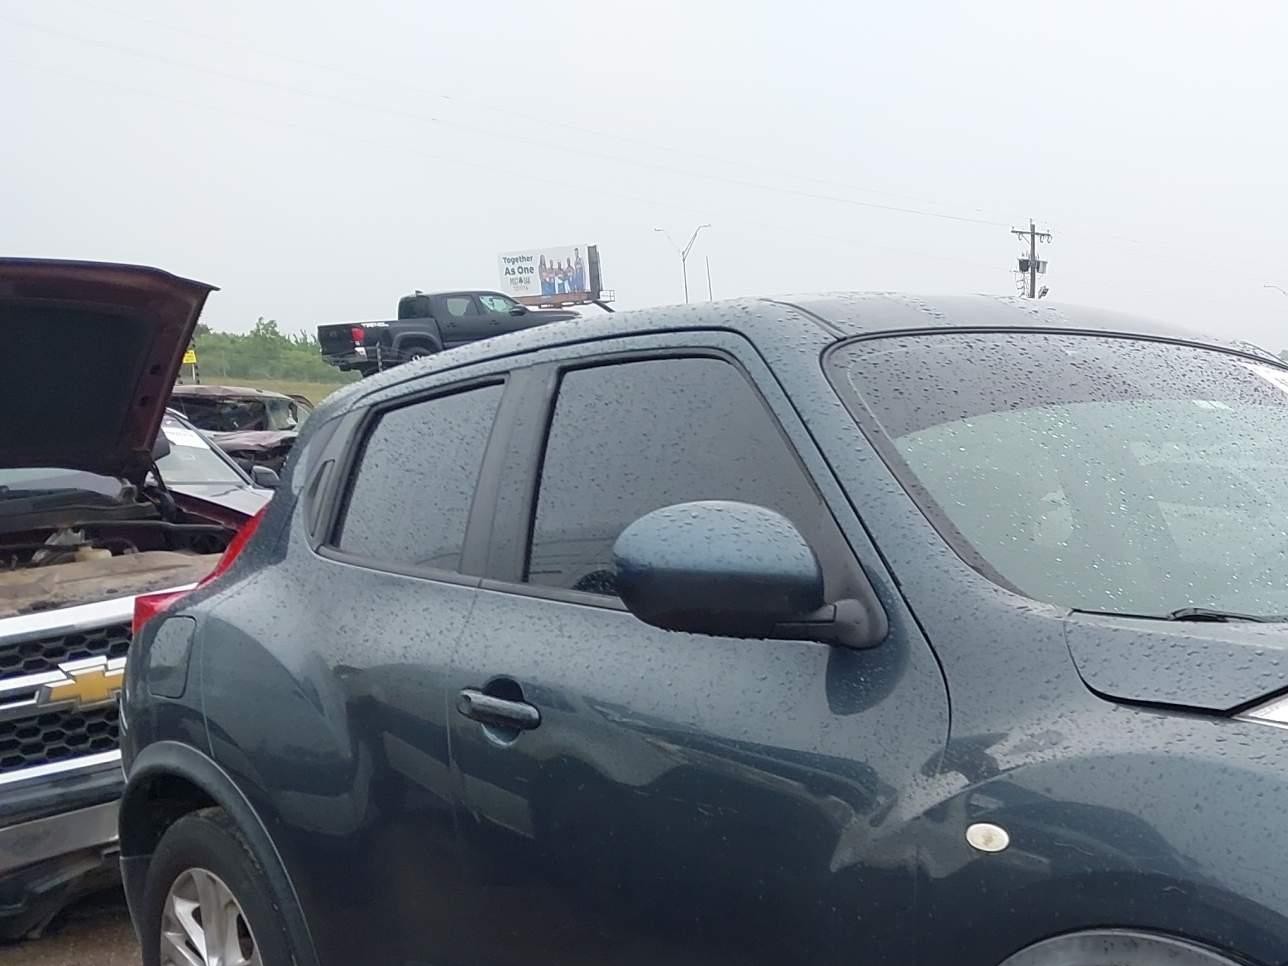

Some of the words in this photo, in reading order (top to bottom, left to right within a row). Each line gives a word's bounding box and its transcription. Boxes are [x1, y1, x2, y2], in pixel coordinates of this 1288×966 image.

[502, 255, 534, 265] Together
[504, 267, 516, 276] As
[517, 266, 535, 275] One
